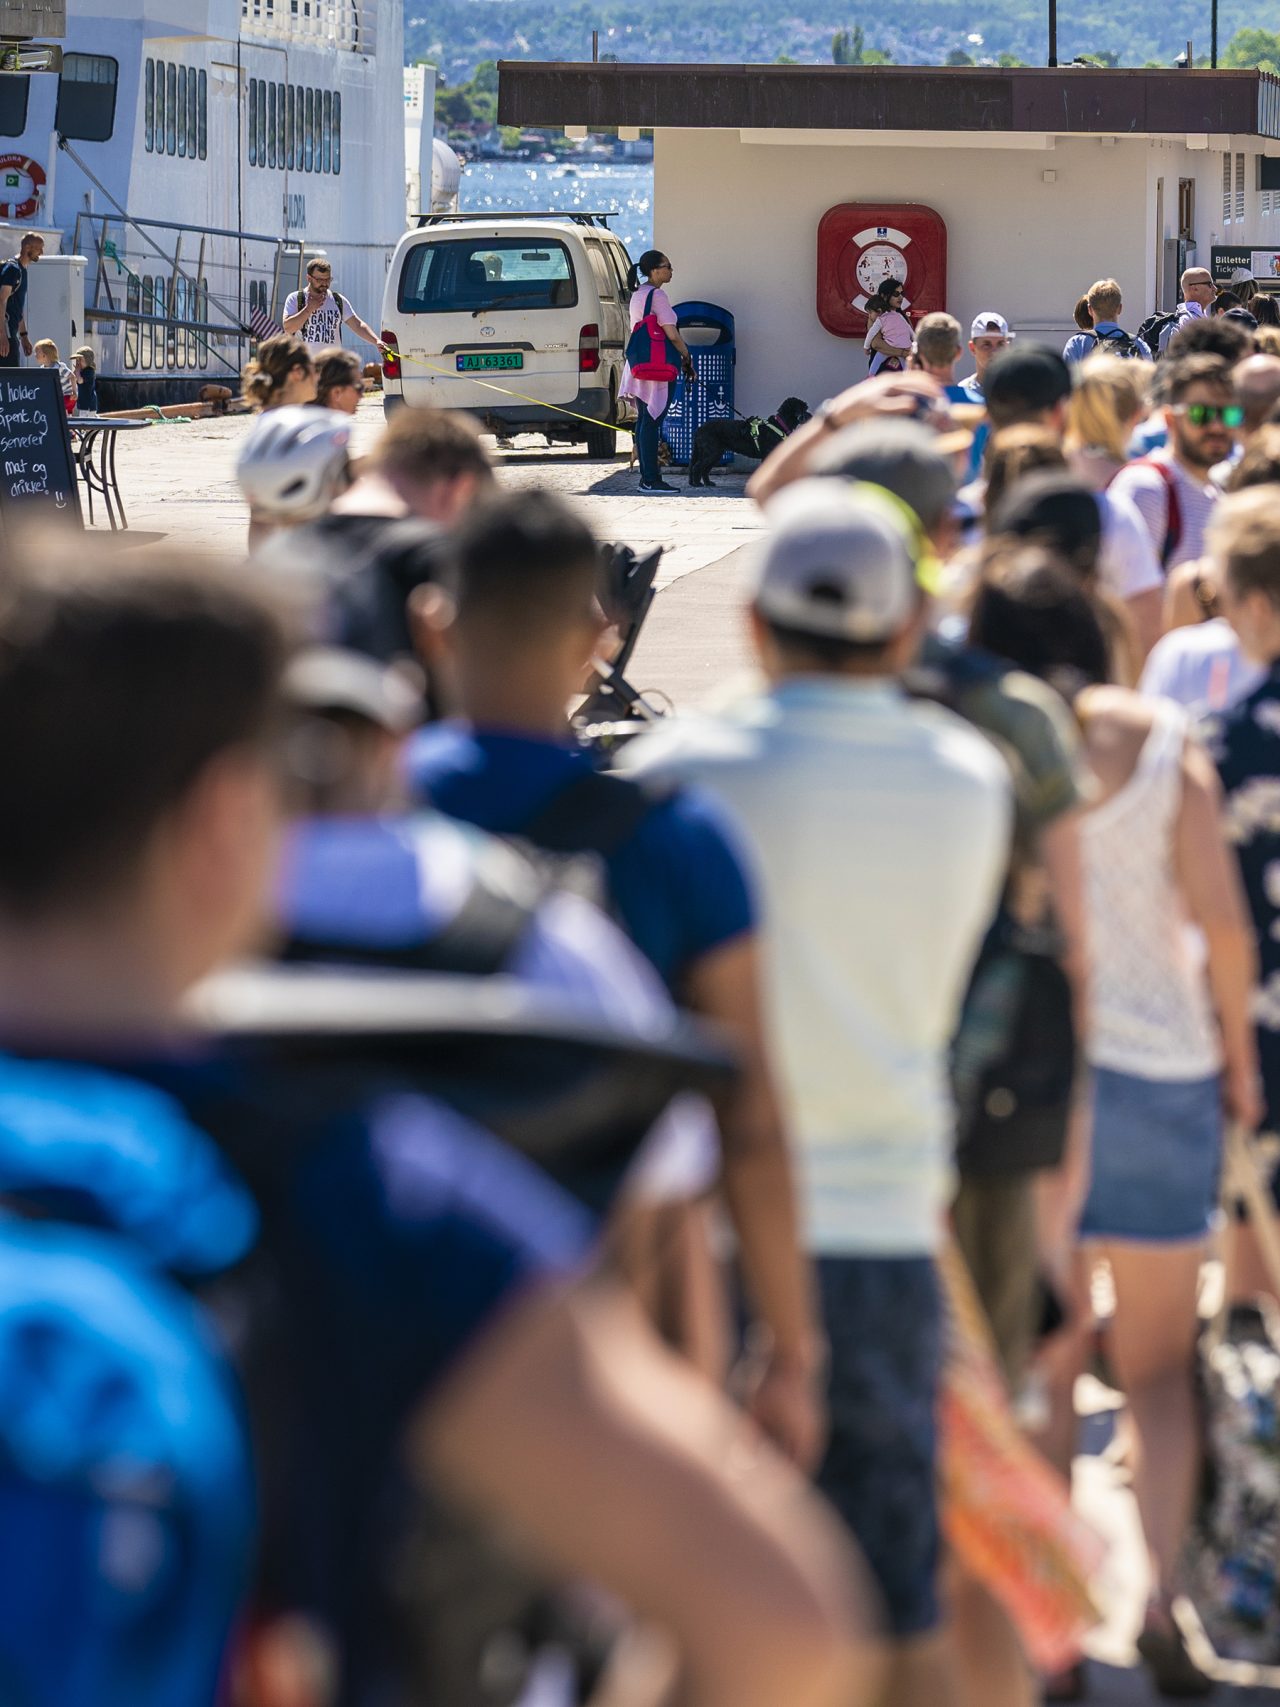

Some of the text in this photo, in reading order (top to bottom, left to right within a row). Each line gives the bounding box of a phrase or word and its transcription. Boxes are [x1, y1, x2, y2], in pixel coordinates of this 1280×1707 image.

[1215, 255, 1251, 264] Billetter
[485, 355, 518, 367] 63361
[7, 381, 40, 403] holder
[33, 410, 48, 434] Og
[32, 463, 48, 480] og
[11, 479, 49, 497] drikke!
